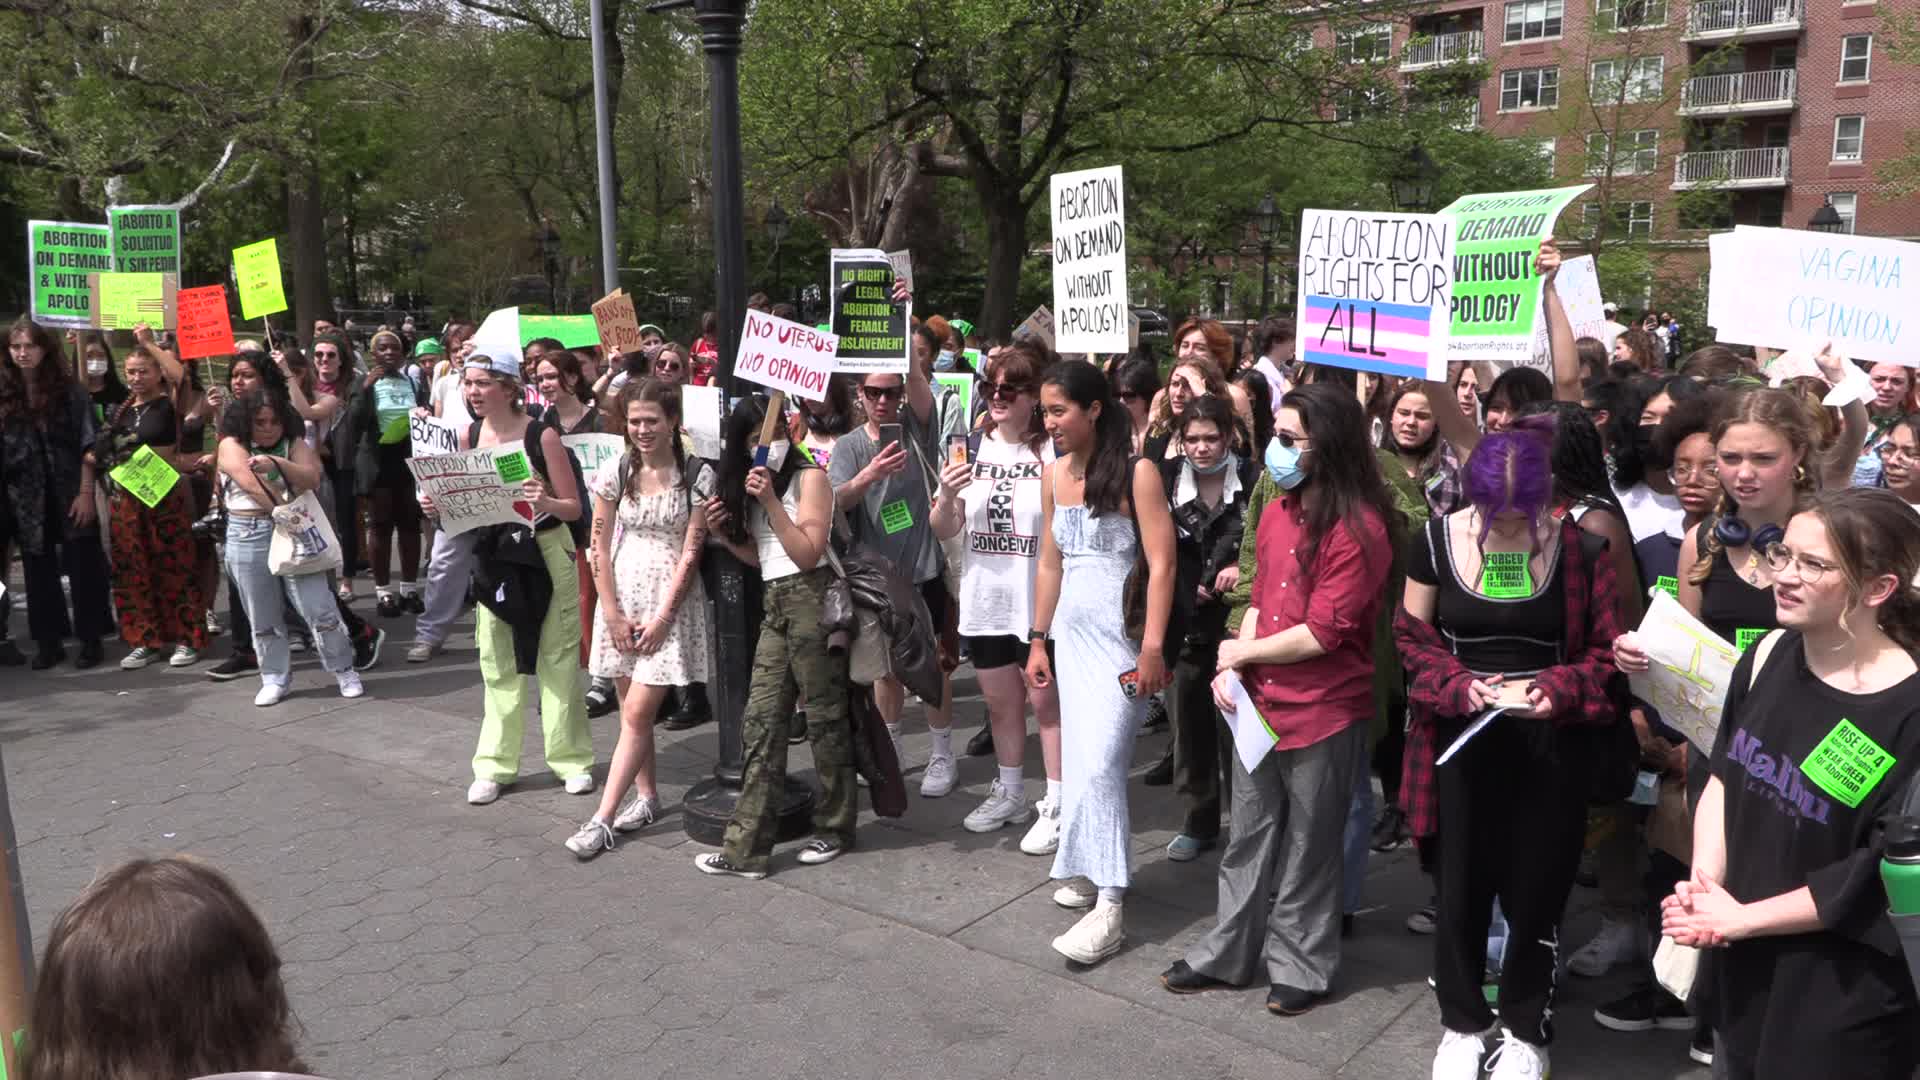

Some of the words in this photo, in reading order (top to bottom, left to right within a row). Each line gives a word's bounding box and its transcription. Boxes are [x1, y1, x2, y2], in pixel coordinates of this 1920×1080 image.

[1059, 177, 1119, 222] ABORTION
[1456, 194, 1558, 213] ABORTION
[166, 214, 173, 229] A
[1457, 213, 1548, 241] DEMAND
[43, 230, 107, 249] ABORTION
[121, 235, 173, 250] SOLICITUD
[1055, 236, 1072, 264] ON
[1075, 220, 1123, 260] DEMAND
[1306, 216, 1447, 262] ABORTION
[37, 251, 54, 266] ON
[118, 256, 126, 272] Y
[129, 256, 148, 272] SIN
[1799, 247, 1903, 289] VAGINA
[41, 273, 49, 288] &
[55, 273, 90, 288] WITH
[841, 269, 855, 282] NO
[857, 269, 885, 282] RIGHT
[1065, 270, 1113, 299] WITHOUT
[1304, 254, 1385, 302] RIGHTS
[1392, 263, 1448, 306] FOR
[48, 294, 89, 310] APOLO
[856, 286, 886, 299] LEGAL
[595, 301, 619, 325] BANS
[842, 303, 890, 317] ABORTION
[1061, 303, 1125, 336] APOLOGY!
[1449, 293, 1521, 324] POLOGY
[850, 320, 889, 333] FEMALE
[1320, 302, 1387, 357] ALL
[1787, 295, 1902, 345] OPINION
[615, 326, 640, 347] BODY
[746, 315, 774, 338] NO
[778, 325, 833, 352] UTERUS
[838, 337, 905, 350] NSLAVEMENT
[739, 351, 764, 372] NO
[768, 358, 826, 392] OPINION
[474, 451, 493, 469] MY
[575, 443, 595, 470] I
[975, 463, 1040, 480] FUCK
[972, 534, 1036, 554] CONCEIVE
[1485, 553, 1524, 564] FORCED
[1836, 725, 1861, 748] RISE
[1858, 742, 1876, 758] UP
[1873, 755, 1886, 768] 4
[1815, 754, 1826, 766] for
[1824, 763, 1861, 793] Abortion
[1823, 747, 1844, 766] WEAR
[1840, 761, 1868, 785] GREEN
